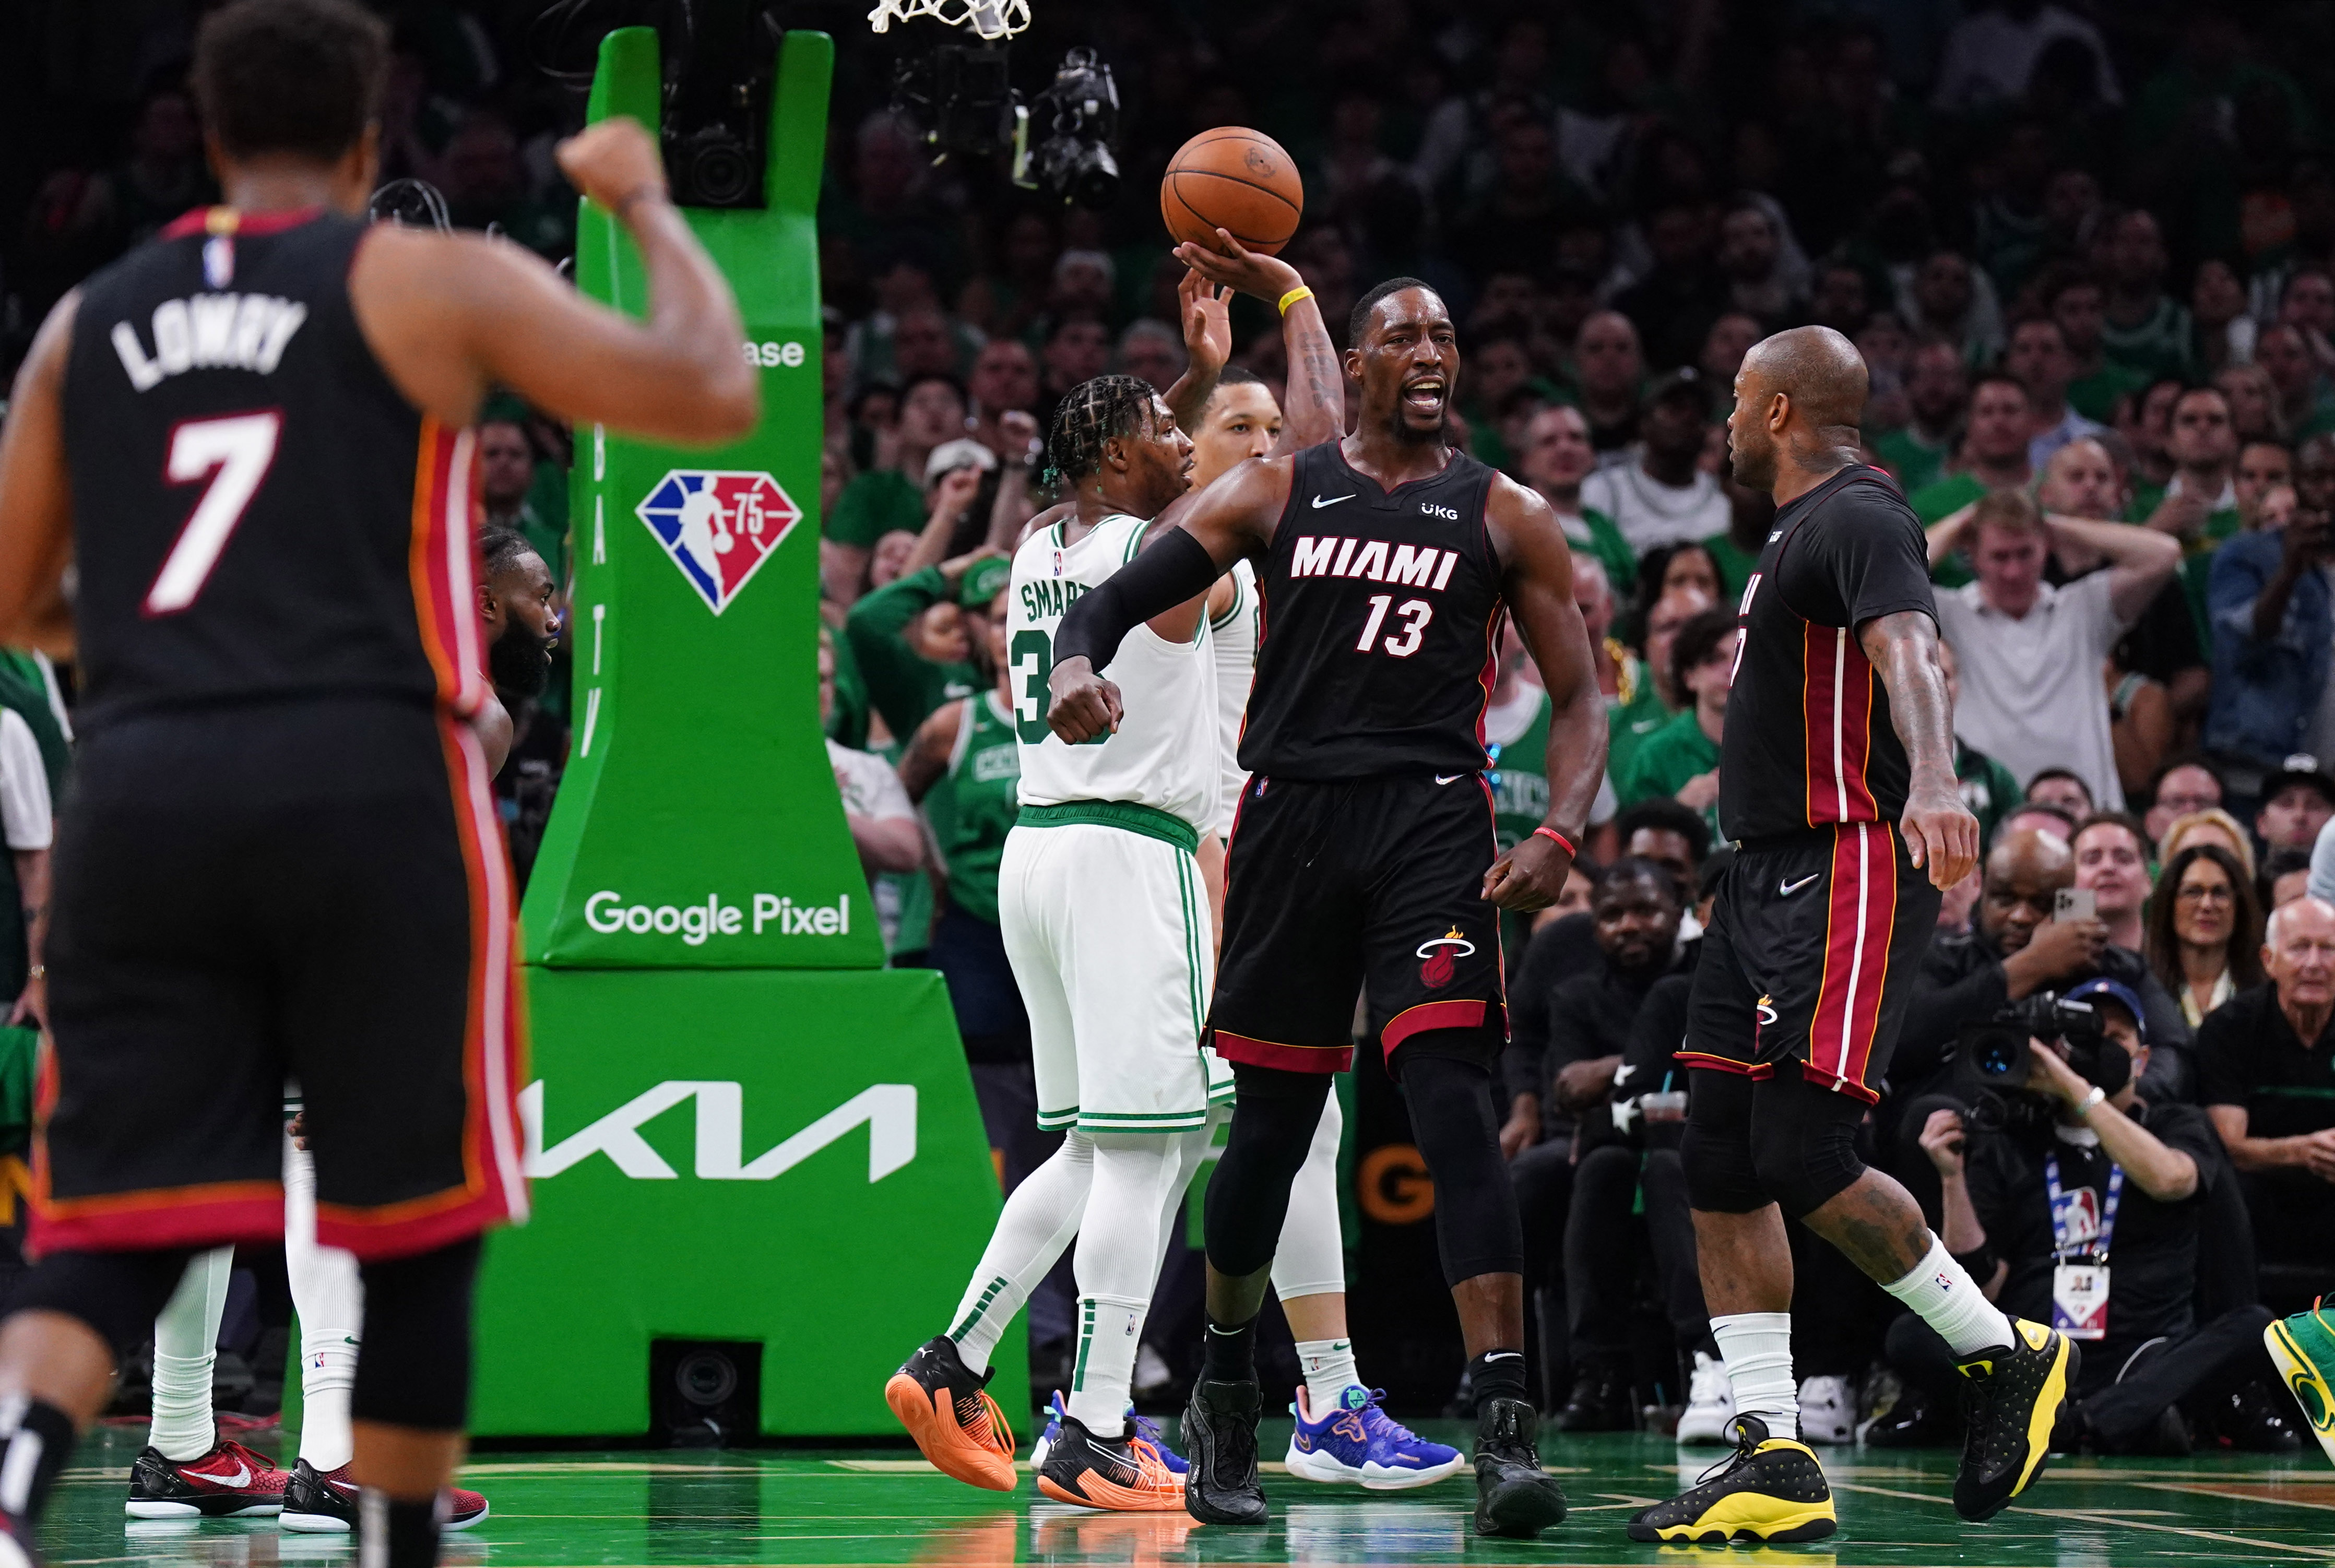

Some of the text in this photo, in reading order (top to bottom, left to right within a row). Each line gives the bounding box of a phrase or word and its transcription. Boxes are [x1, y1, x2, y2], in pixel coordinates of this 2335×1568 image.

[111, 292, 307, 393] LOWRY
[742, 341, 805, 367] ase
[141, 409, 285, 620] 7
[733, 493, 764, 535] 75
[1421, 502, 1459, 521] UKG
[1290, 536, 1461, 592] MIAMI
[1354, 592, 1435, 659] 13
[1011, 629, 1112, 744] 3
[584, 890, 849, 945] Google Pixel
[518, 1079, 917, 1183] KIA
